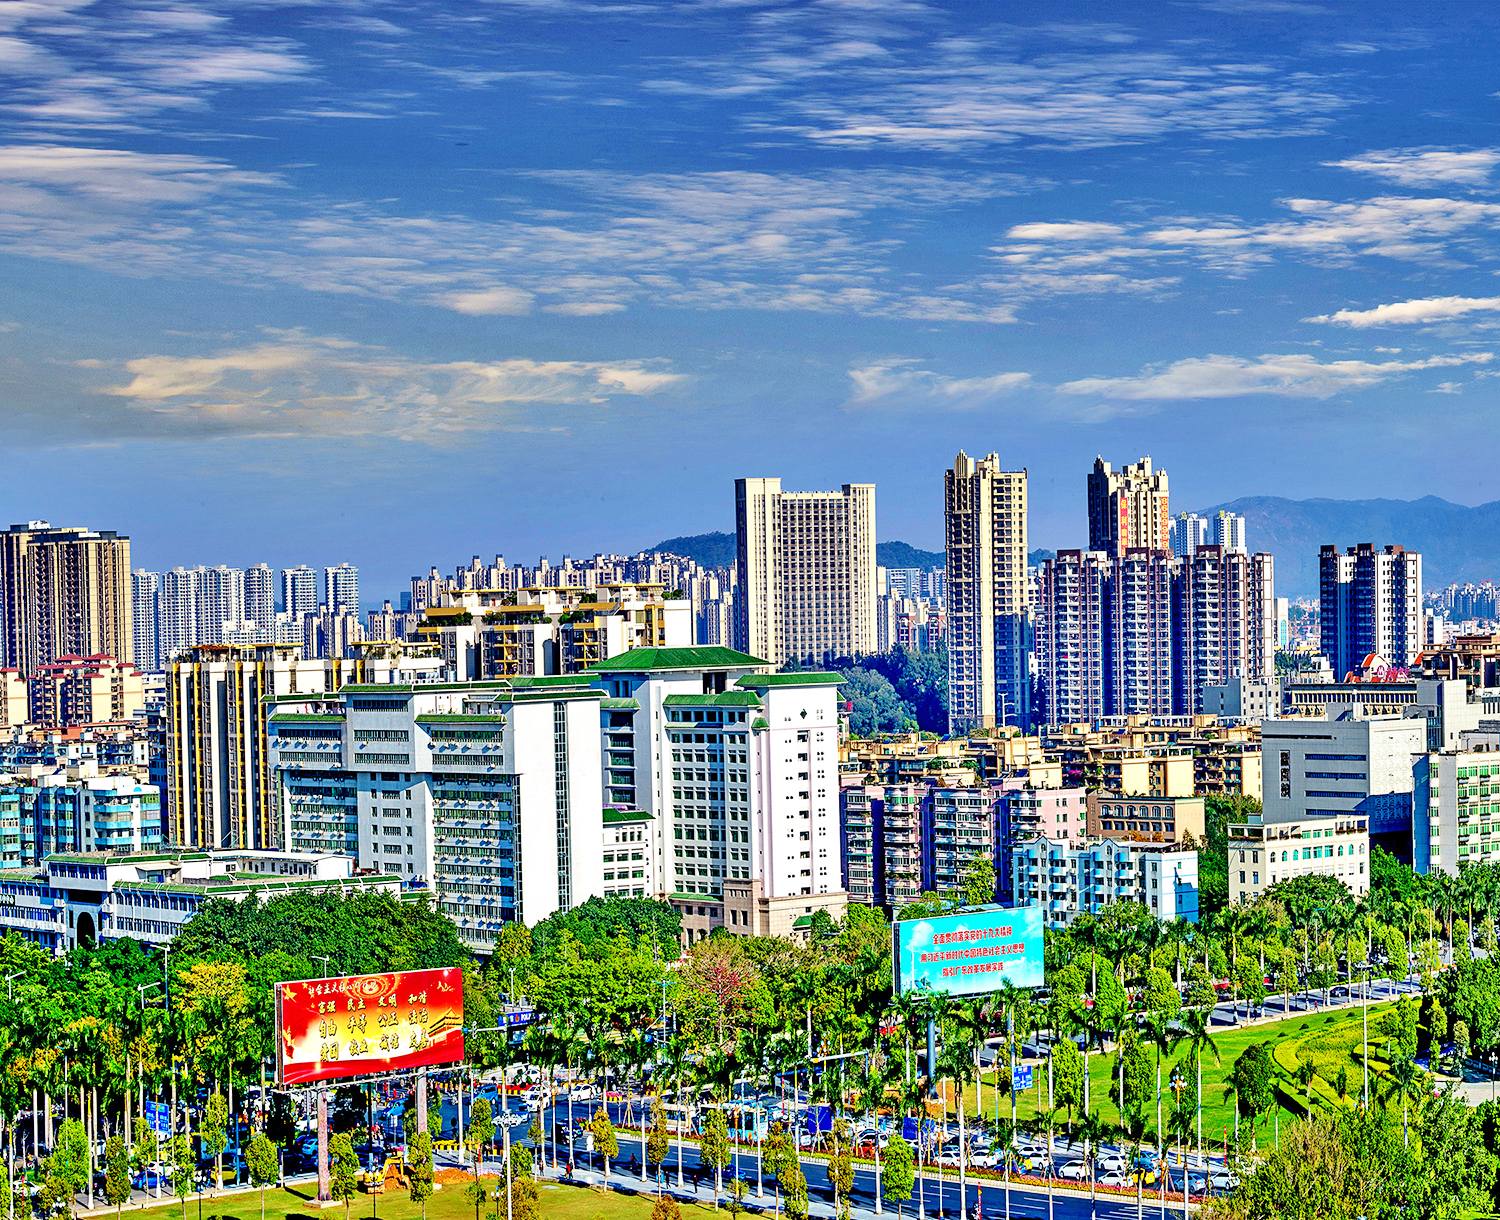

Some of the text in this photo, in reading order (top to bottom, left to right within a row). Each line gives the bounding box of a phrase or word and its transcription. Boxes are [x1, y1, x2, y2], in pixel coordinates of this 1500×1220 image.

[318, 1000, 336, 1014] 富强
[347, 998, 366, 1012] 民主
[378, 994, 398, 1009] 文明
[319, 1008, 429, 1039] 自由 平等 公正 法治
